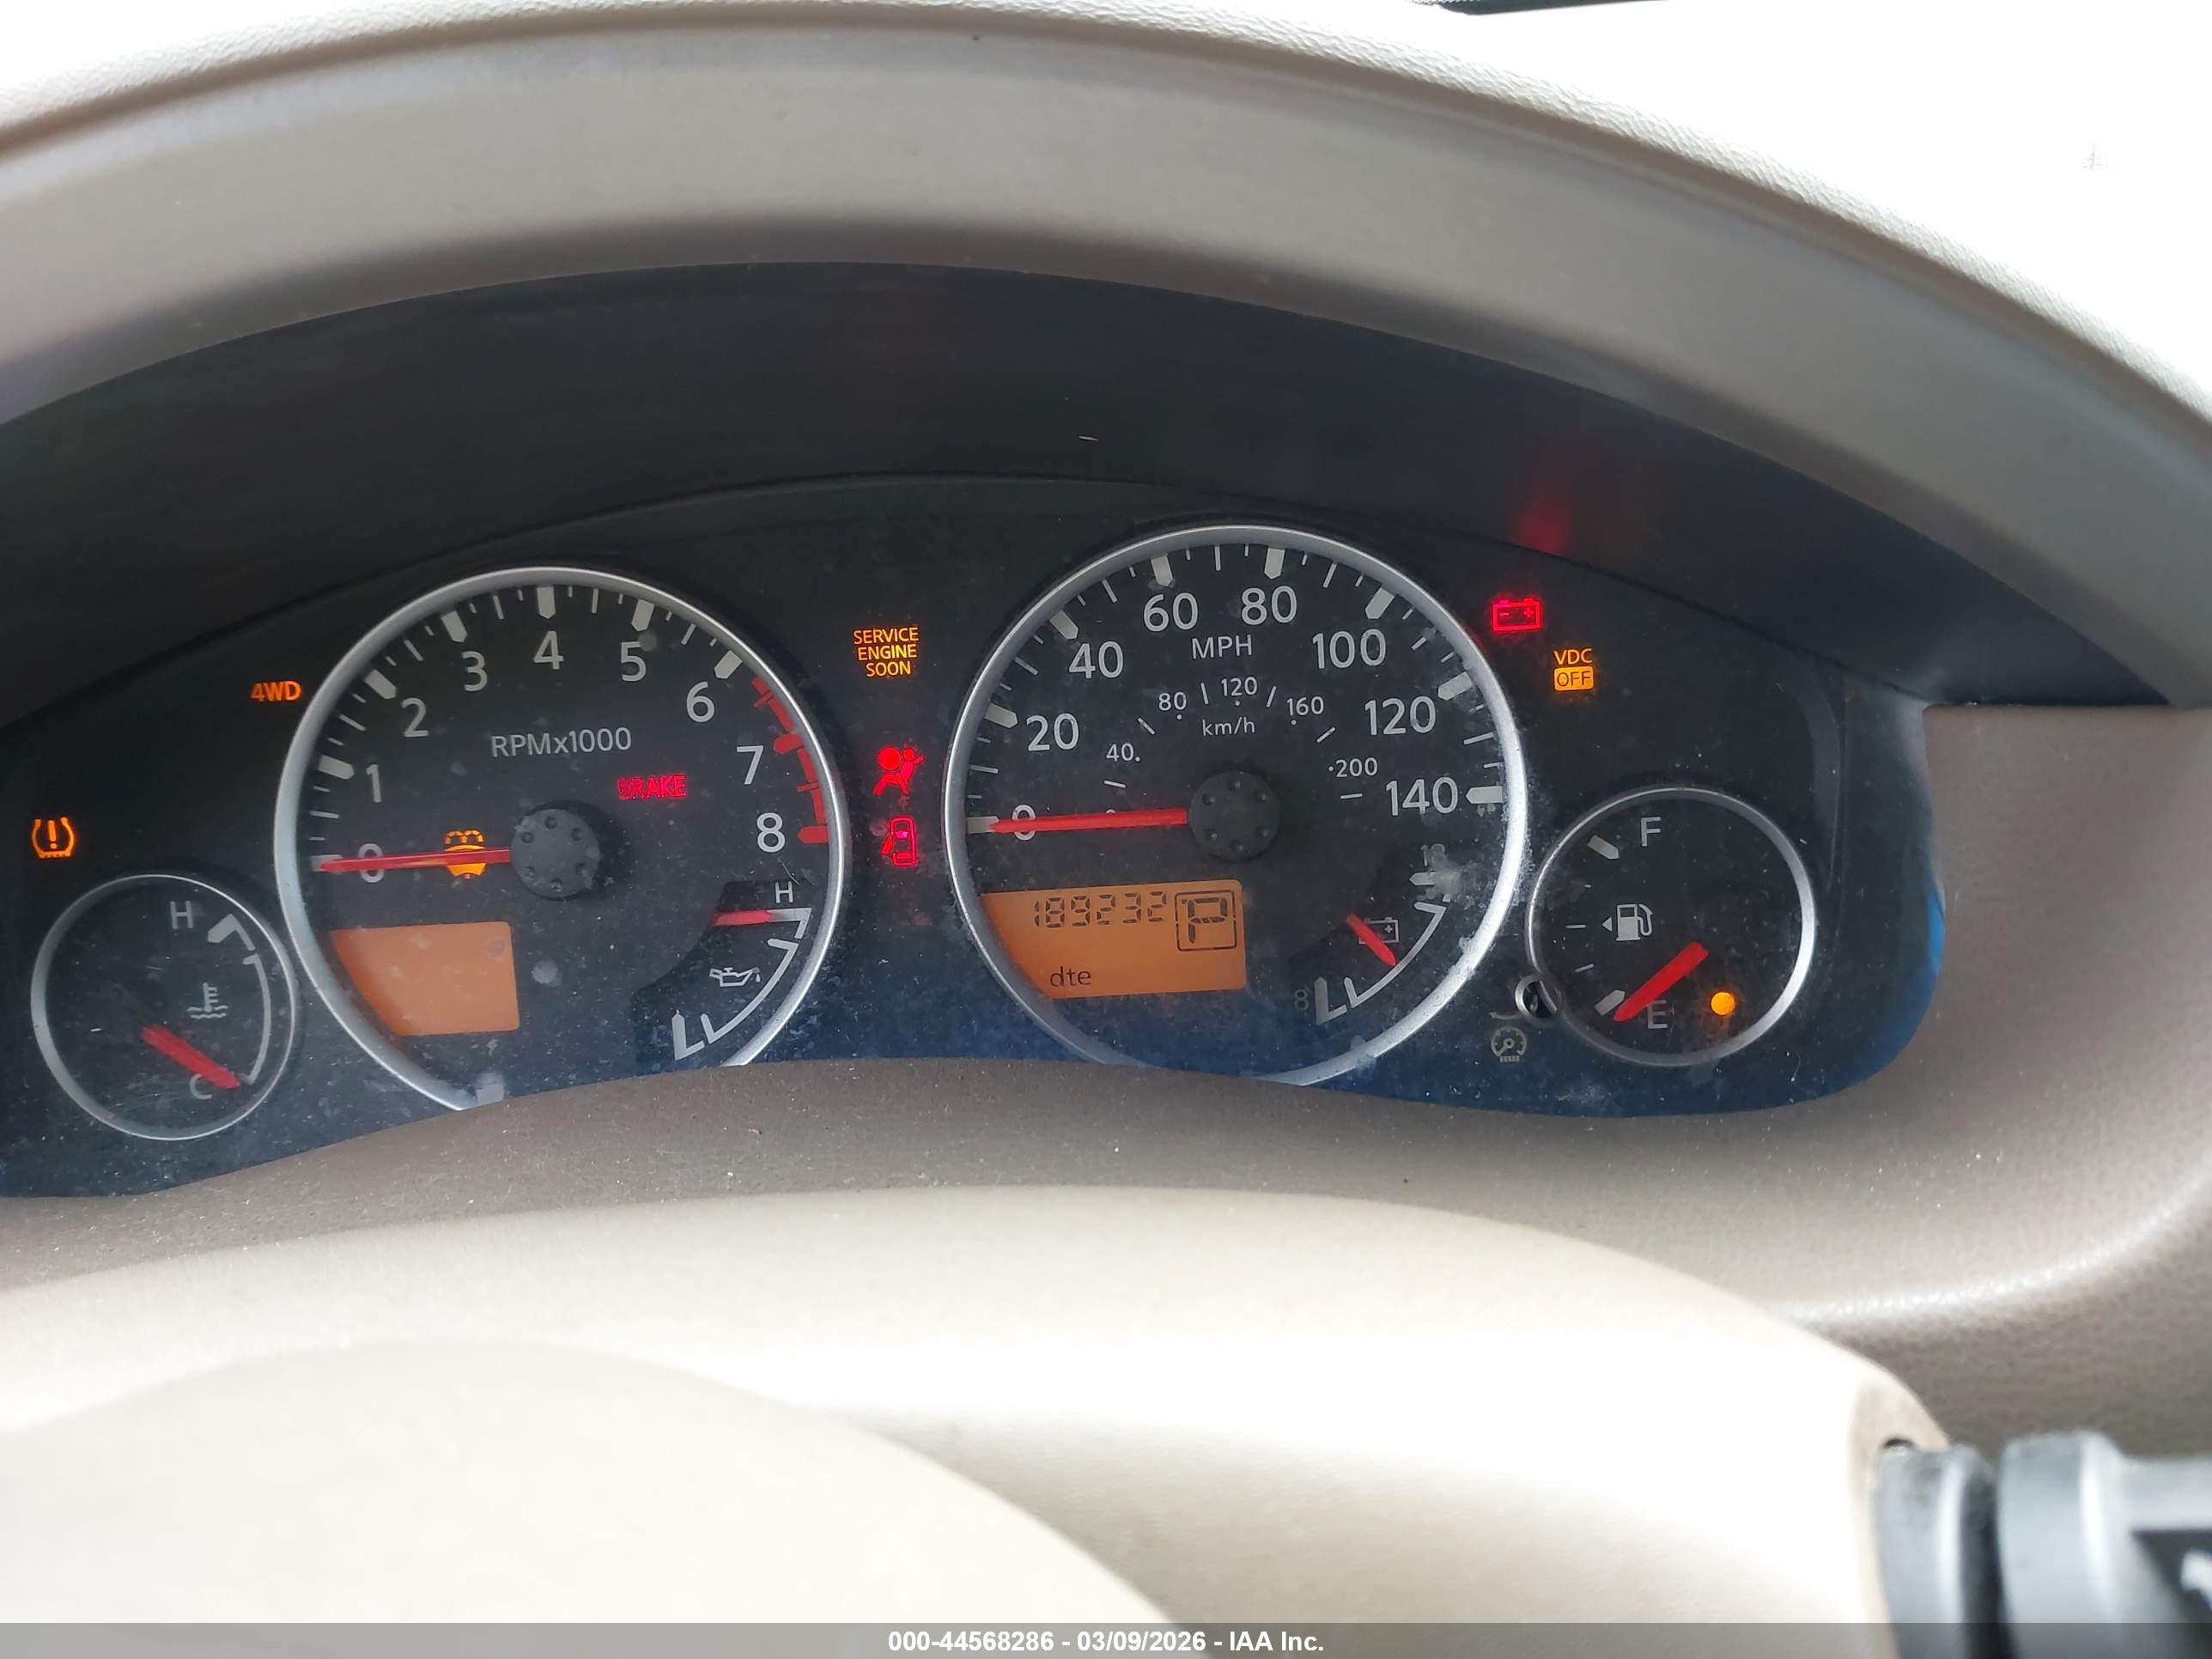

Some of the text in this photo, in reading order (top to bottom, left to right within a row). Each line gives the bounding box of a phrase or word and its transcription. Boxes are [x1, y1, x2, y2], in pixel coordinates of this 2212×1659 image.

[1142, 592, 1199, 633] 60
[1240, 586, 1297, 625] 80
[533, 630, 564, 671] 4
[853, 627, 919, 644] SERVICE
[1191, 635, 1254, 660] MPH
[1311, 628, 1387, 670] 100
[620, 641, 647, 683] 5
[858, 643, 917, 661] ENGINE
[1067, 640, 1124, 680] 40
[1553, 647, 1593, 665] VDC
[464, 651, 489, 692] 3
[866, 660, 911, 677] SOON
[1556, 671, 1592, 688] OFF
[251, 680, 302, 702] 4WD
[687, 682, 714, 723] 6
[1158, 691, 1187, 711] 80
[1221, 677, 1258, 697] 120
[402, 698, 428, 738] 2
[1287, 696, 1324, 716] 160
[1364, 696, 1437, 737] 120
[491, 726, 632, 757] RPMx1000
[1027, 713, 1079, 752] 20
[1202, 716, 1255, 737] km/h
[736, 745, 763, 785] 7
[1335, 757, 1378, 778] 200
[365, 764, 382, 803] 1
[618, 774, 687, 800] BRAKE
[1385, 776, 1459, 817] 140
[756, 812, 786, 854] 8
[1012, 804, 1036, 842] 0
[1640, 816, 1662, 847] F
[358, 843, 385, 884] 0
[774, 883, 793, 903] H
[170, 901, 194, 930] H
[1034, 890, 1167, 928] 189232
[1182, 896, 1228, 944] P
[1049, 966, 1092, 988] dte
[1647, 1000, 1668, 1030] E
[189, 1073, 214, 1100] C
